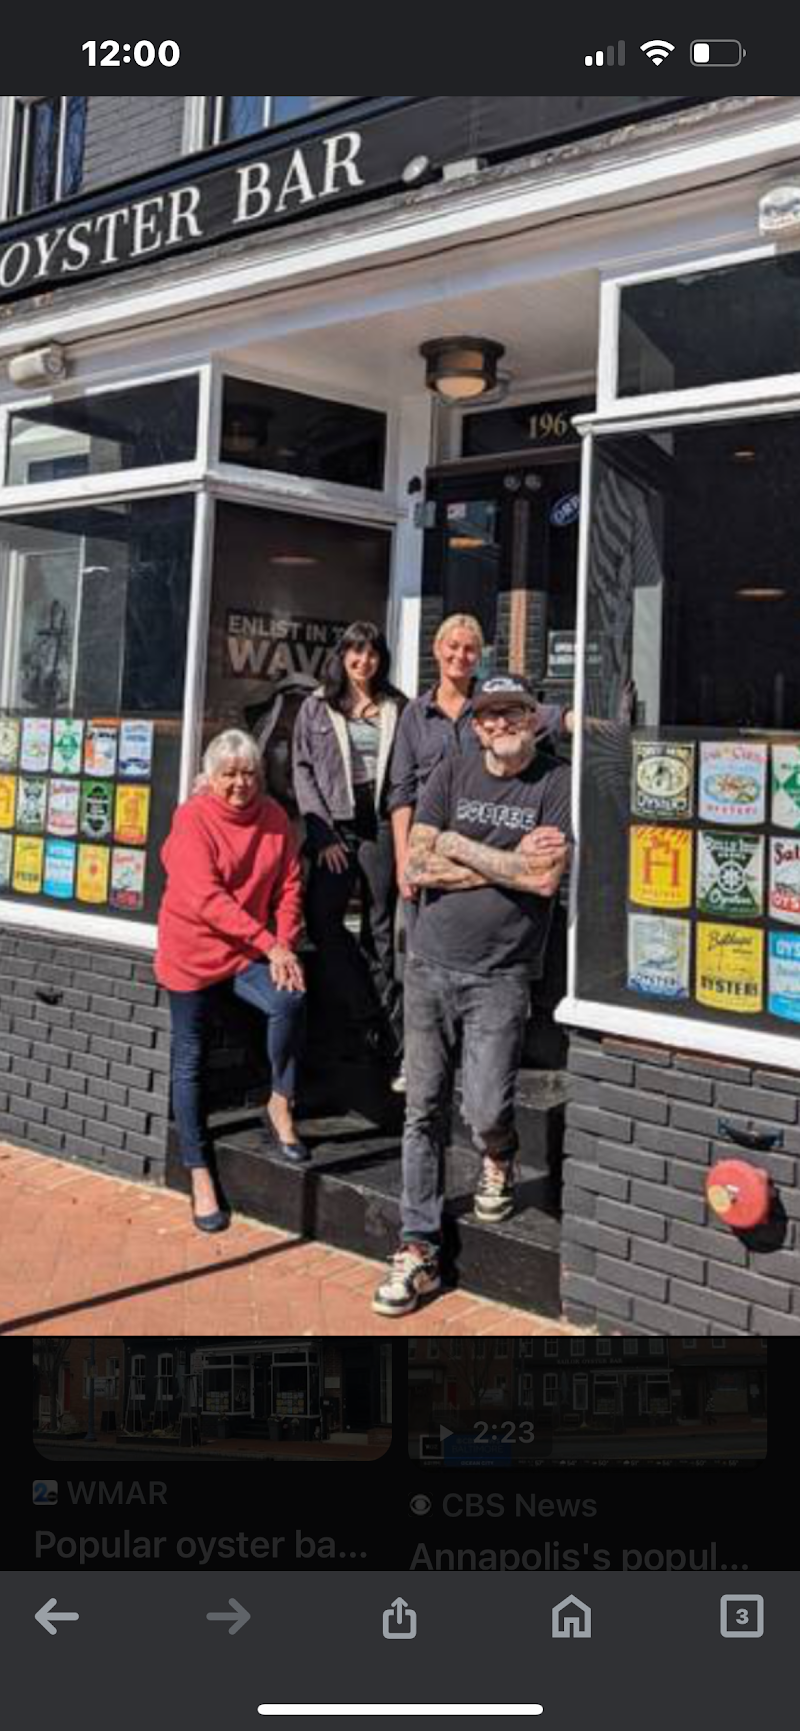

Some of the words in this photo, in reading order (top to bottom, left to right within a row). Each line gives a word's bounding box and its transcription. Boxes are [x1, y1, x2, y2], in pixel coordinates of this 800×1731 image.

[82, 41, 180, 66] 12:00
[0, 186, 203, 288] OYSTER
[232, 131, 365, 224] BAR
[528, 413, 567, 438] 196
[227, 615, 300, 641] ENLIST
[306, 624, 327, 643] IN
[226, 637, 334, 679] WAV
[473, 1421, 536, 1444] 2:23
[67, 1481, 168, 1504] WMAR
[442, 1493, 505, 1517] CBS
[515, 1493, 598, 1517] News
[35, 1529, 166, 1564] Popular
[176, 1532, 285, 1564] oyster
[295, 1529, 367, 1558] ba...
[409, 1541, 611, 1571] Annapolis's
[622, 1541, 749, 1571] popul...
[735, 1608, 749, 1625] 3
